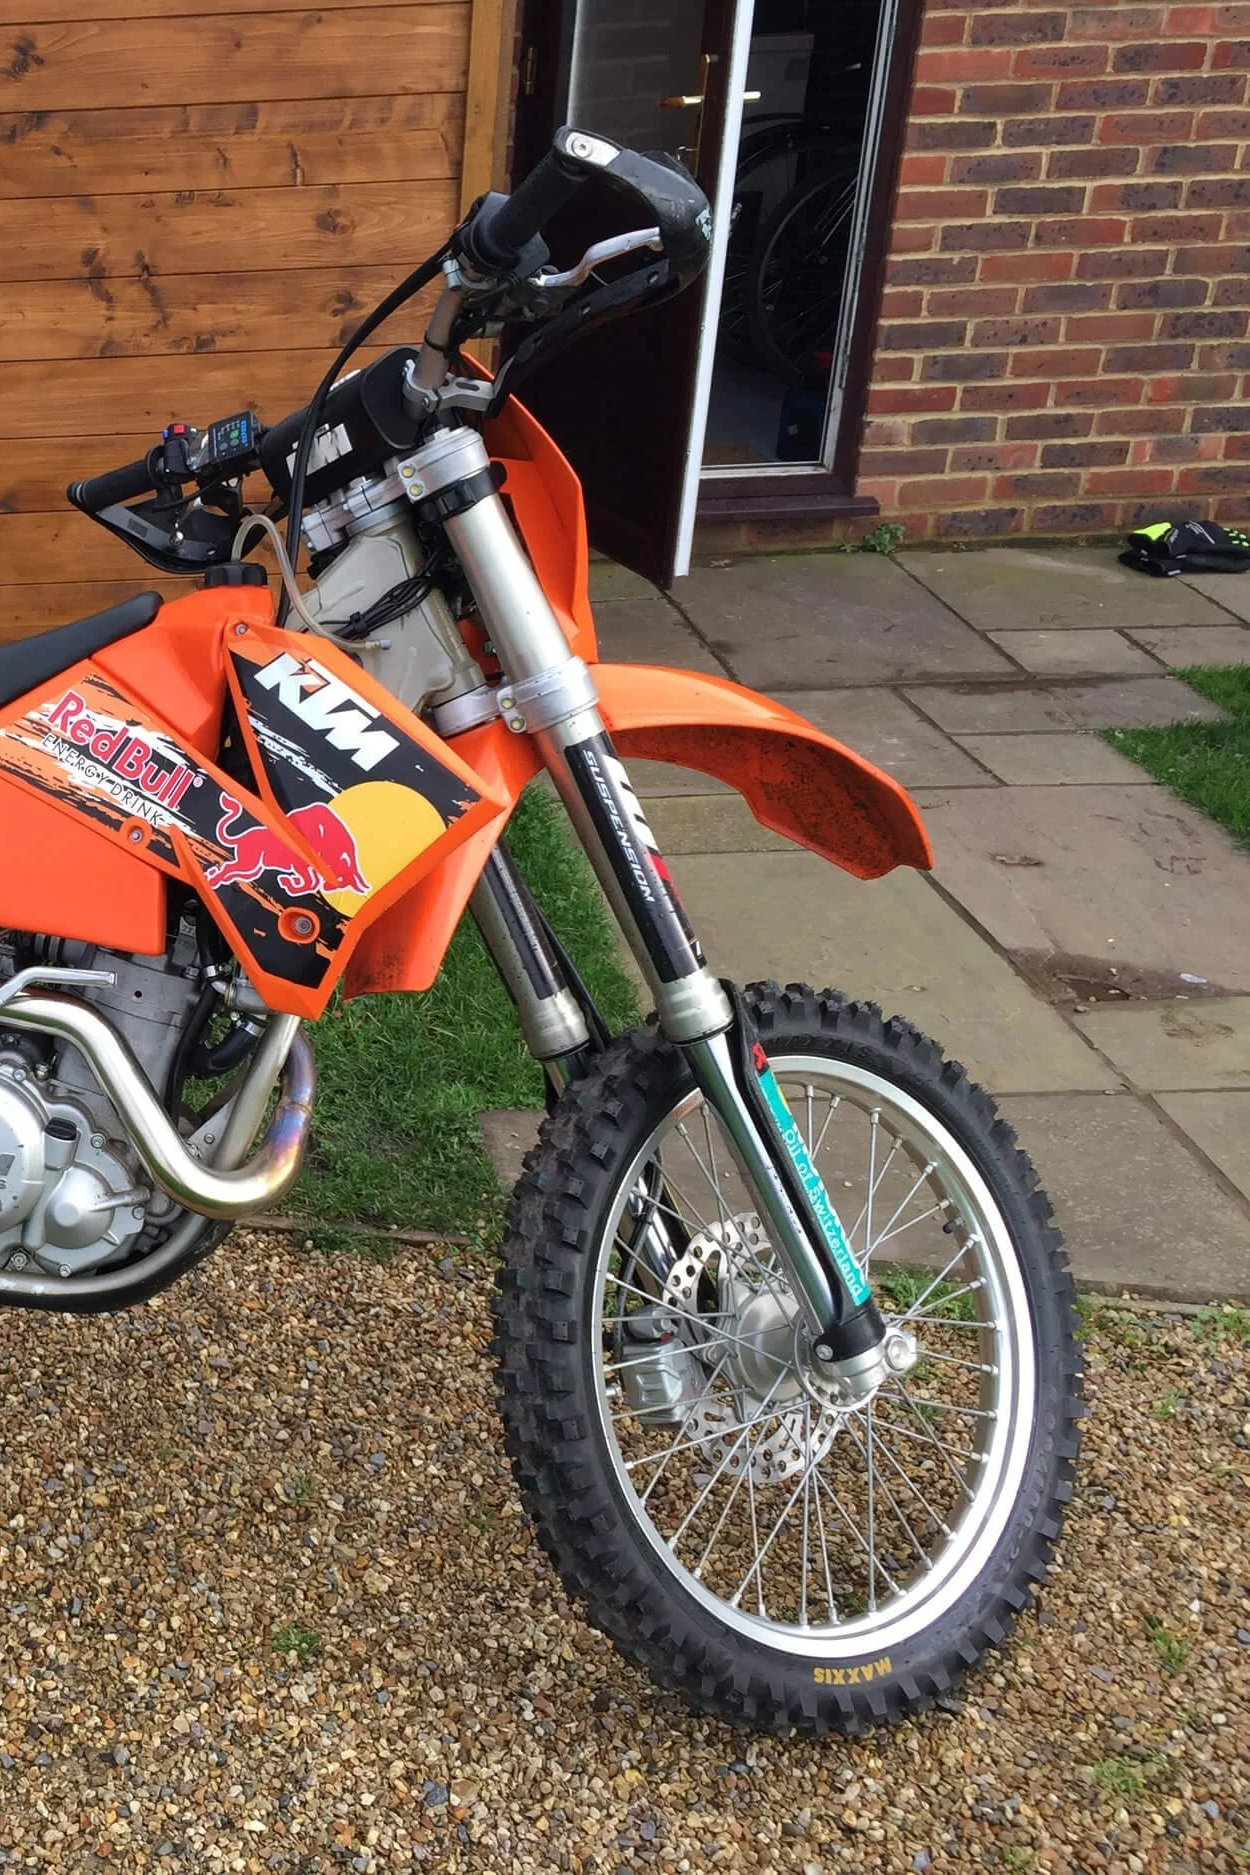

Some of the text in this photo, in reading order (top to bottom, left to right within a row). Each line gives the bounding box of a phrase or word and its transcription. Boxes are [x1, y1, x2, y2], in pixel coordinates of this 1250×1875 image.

[254, 652, 401, 772] KTM
[43, 734, 164, 826] ENERGY DRINK
[582, 749, 655, 904] SUSPENSION
[784, 1129, 803, 1158] Oil
[809, 1186, 864, 1295] Switzerland
[813, 1656, 892, 1685] MAXXIS
